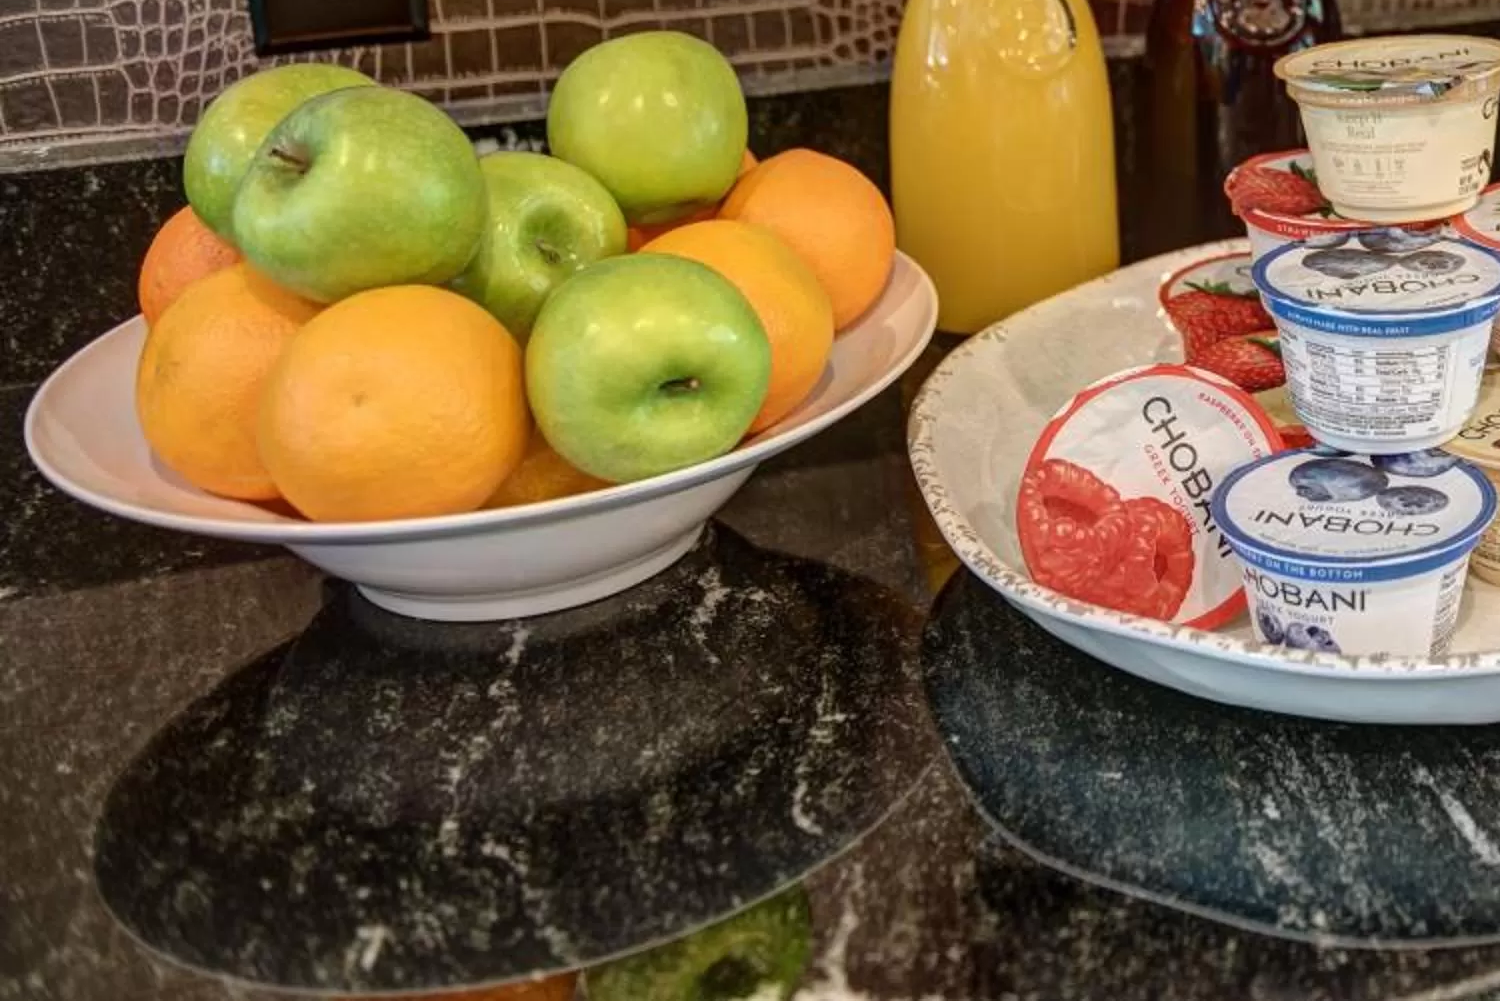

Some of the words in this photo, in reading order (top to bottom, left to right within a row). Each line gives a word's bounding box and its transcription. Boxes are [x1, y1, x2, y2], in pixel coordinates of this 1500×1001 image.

[1305, 273, 1480, 300] CHOBANI
[1143, 443, 1171, 486] GREEK
[1254, 509, 1441, 537] CHOBANI
[1265, 557, 1280, 569] ON
[1283, 562, 1305, 576] THE
[1309, 566, 1364, 580] BOTTOM
